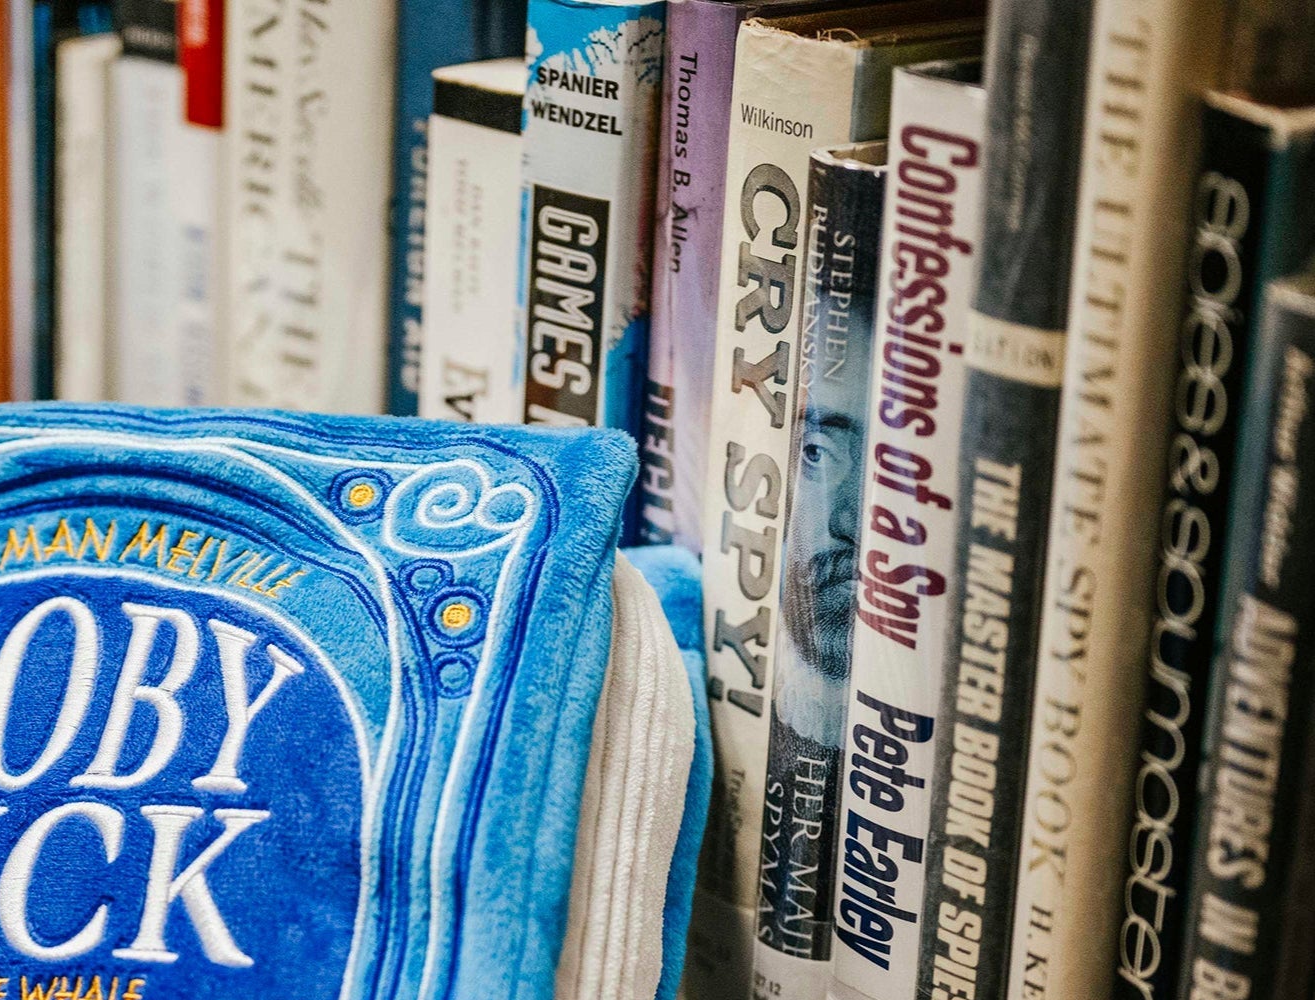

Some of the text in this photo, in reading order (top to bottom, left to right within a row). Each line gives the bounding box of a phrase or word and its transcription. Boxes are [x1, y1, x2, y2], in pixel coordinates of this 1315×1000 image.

[532, 99, 623, 137] WENDZEL
[536, 66, 620, 101] SPANIER
[741, 103, 814, 140] Wilkinson
[669, 51, 699, 273] Thomas B. Allen
[530, 204, 600, 396] GAMES
[801, 203, 829, 405] BUDIANSKY
[823, 231, 856, 386] STEPHEN
[709, 163, 802, 719] CRY SPY!
[856, 124, 980, 651] Confessions of a Spy
[118, 521, 309, 601] MELVILLE
[971, 458, 1022, 541] THE
[955, 543, 1015, 723] MASTER
[1051, 556, 1098, 684] SPY
[790, 753, 828, 851] HER
[945, 722, 1000, 849] BOOK
[1028, 696, 1082, 890] BOOK
[1205, 593, 1299, 891] ADVENTURES
[836, 689, 936, 971] Pete Earley
[942, 845, 988, 906] OF
[1199, 893, 1259, 954] IN
